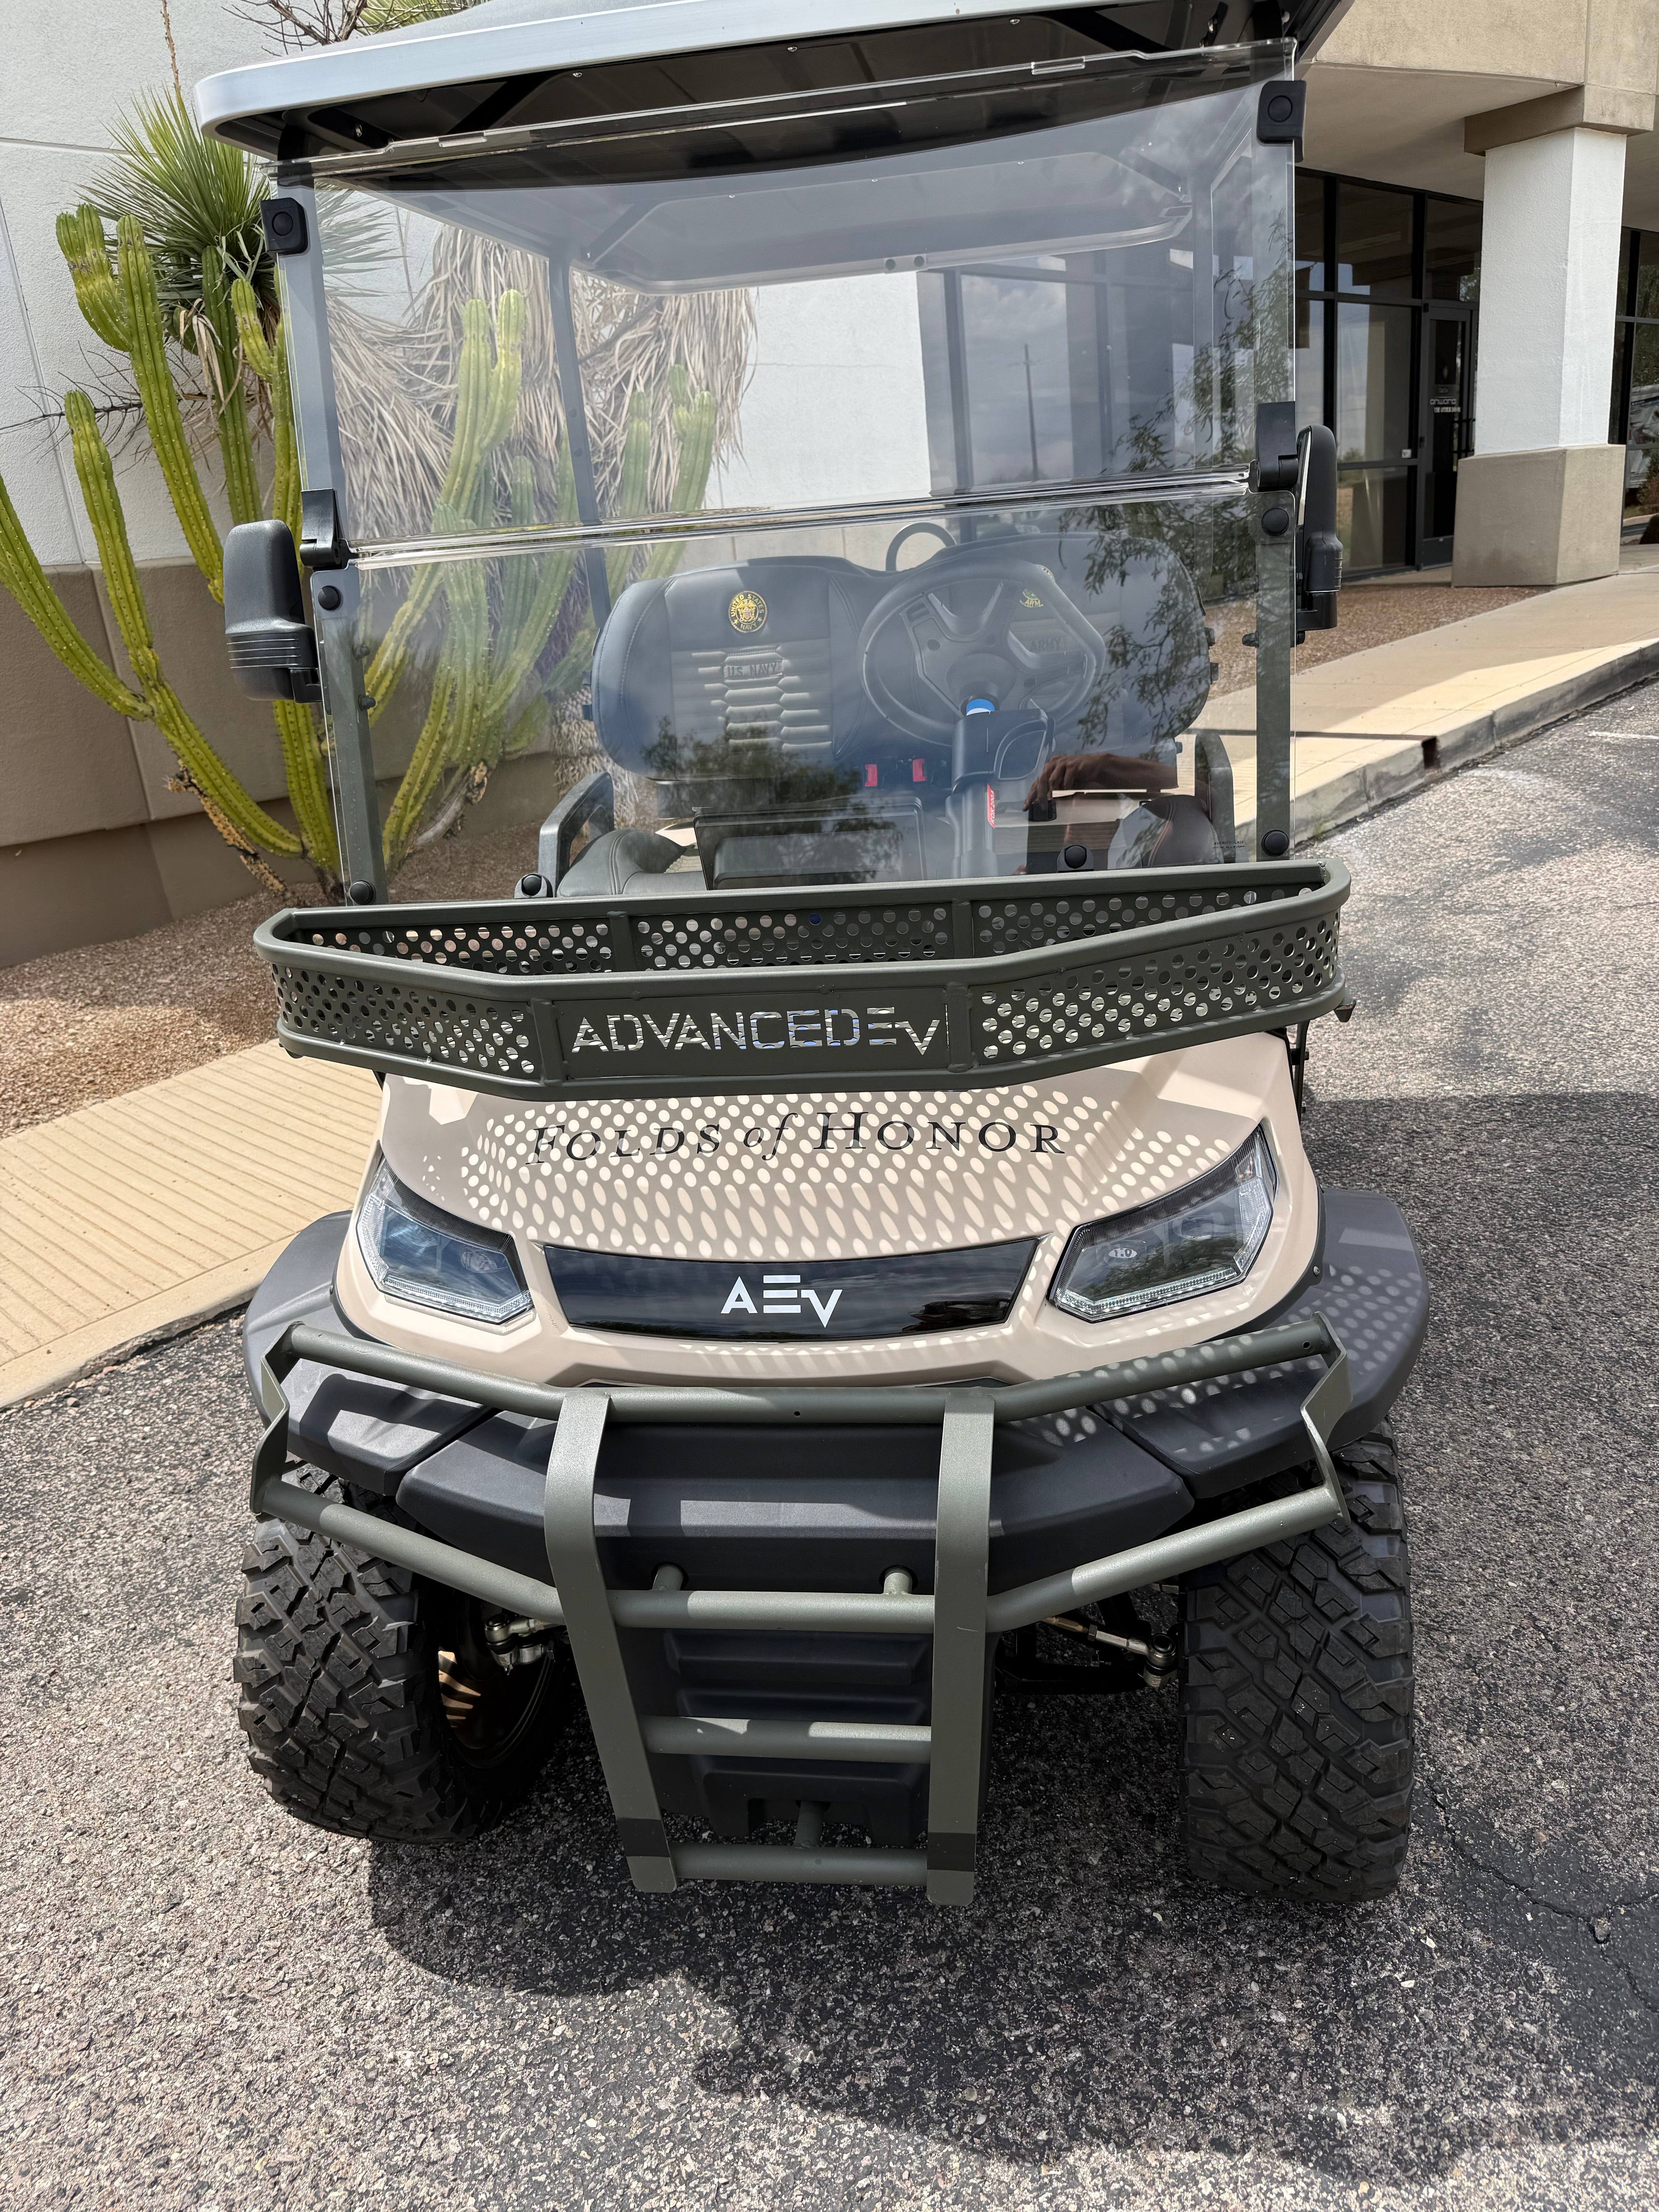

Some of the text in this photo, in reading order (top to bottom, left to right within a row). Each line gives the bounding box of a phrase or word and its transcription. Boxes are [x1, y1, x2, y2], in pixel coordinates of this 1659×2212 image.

[730, 594, 764, 617] UNITED STATES
[1024, 599, 1041, 607] ARM
[740, 622, 757, 630] NAVY
[1029, 637, 1061, 651] ARMY
[750, 662, 776, 676] NAVY
[525, 1111, 1066, 1165] FOLDS of HONOR
[720, 1274, 843, 1328] AEV
